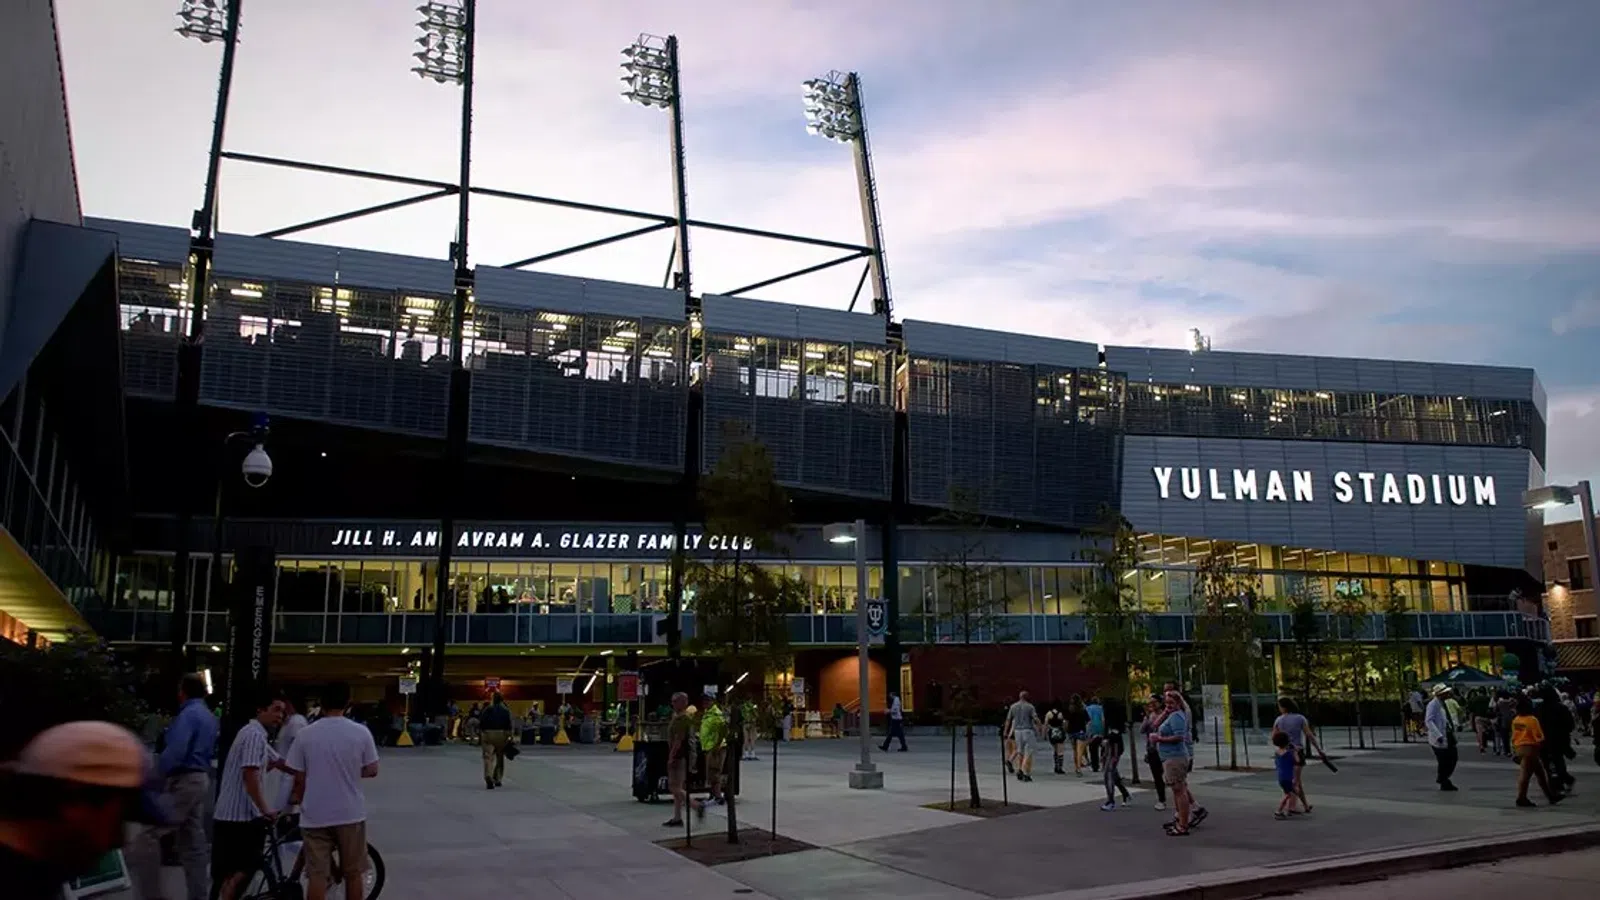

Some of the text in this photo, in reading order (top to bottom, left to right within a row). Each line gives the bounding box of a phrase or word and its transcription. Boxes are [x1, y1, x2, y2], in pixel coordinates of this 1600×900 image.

[1153, 467, 1497, 506] YULMAN STADIUM
[331, 529, 373, 546] JILL
[382, 530, 402, 546] H.
[457, 531, 525, 548] AVRAM
[530, 532, 550, 549] A.
[559, 533, 629, 549] GLAZER
[252, 585, 265, 680] EMERGENCY
